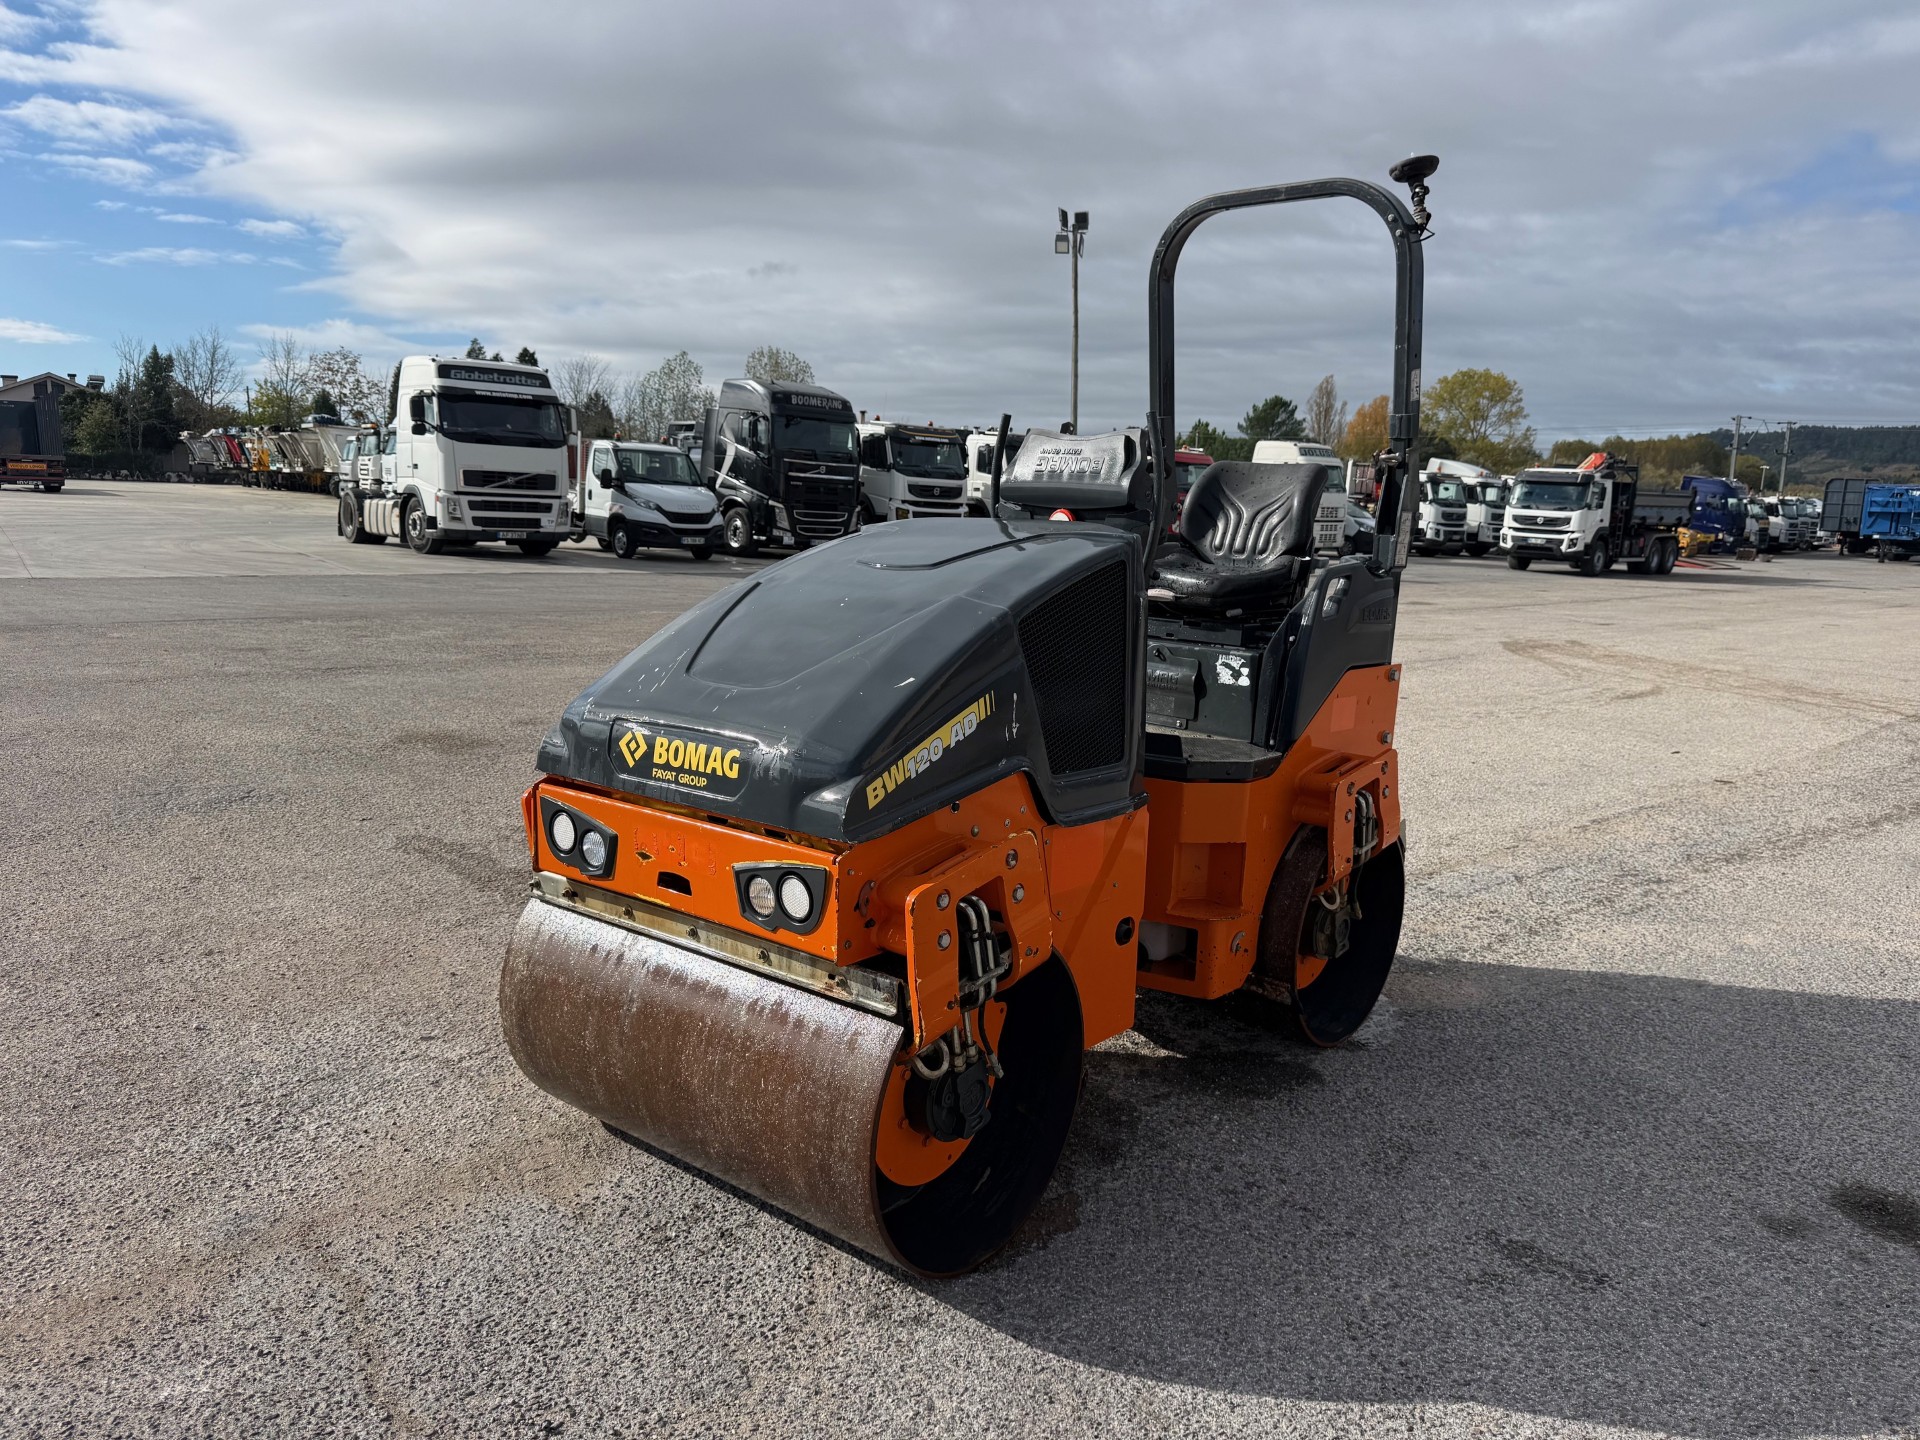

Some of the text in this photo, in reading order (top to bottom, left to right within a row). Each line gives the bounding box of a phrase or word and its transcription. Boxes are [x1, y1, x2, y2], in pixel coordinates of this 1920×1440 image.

[450, 369, 542, 387] Globetrotter
[791, 394, 843, 410] BOOMERANG
[1034, 457, 1106, 474] BOMAG
[950, 711, 978, 749] AD
[653, 736, 741, 779] BOMAG
[652, 767, 707, 787] FAYAT GROUP
